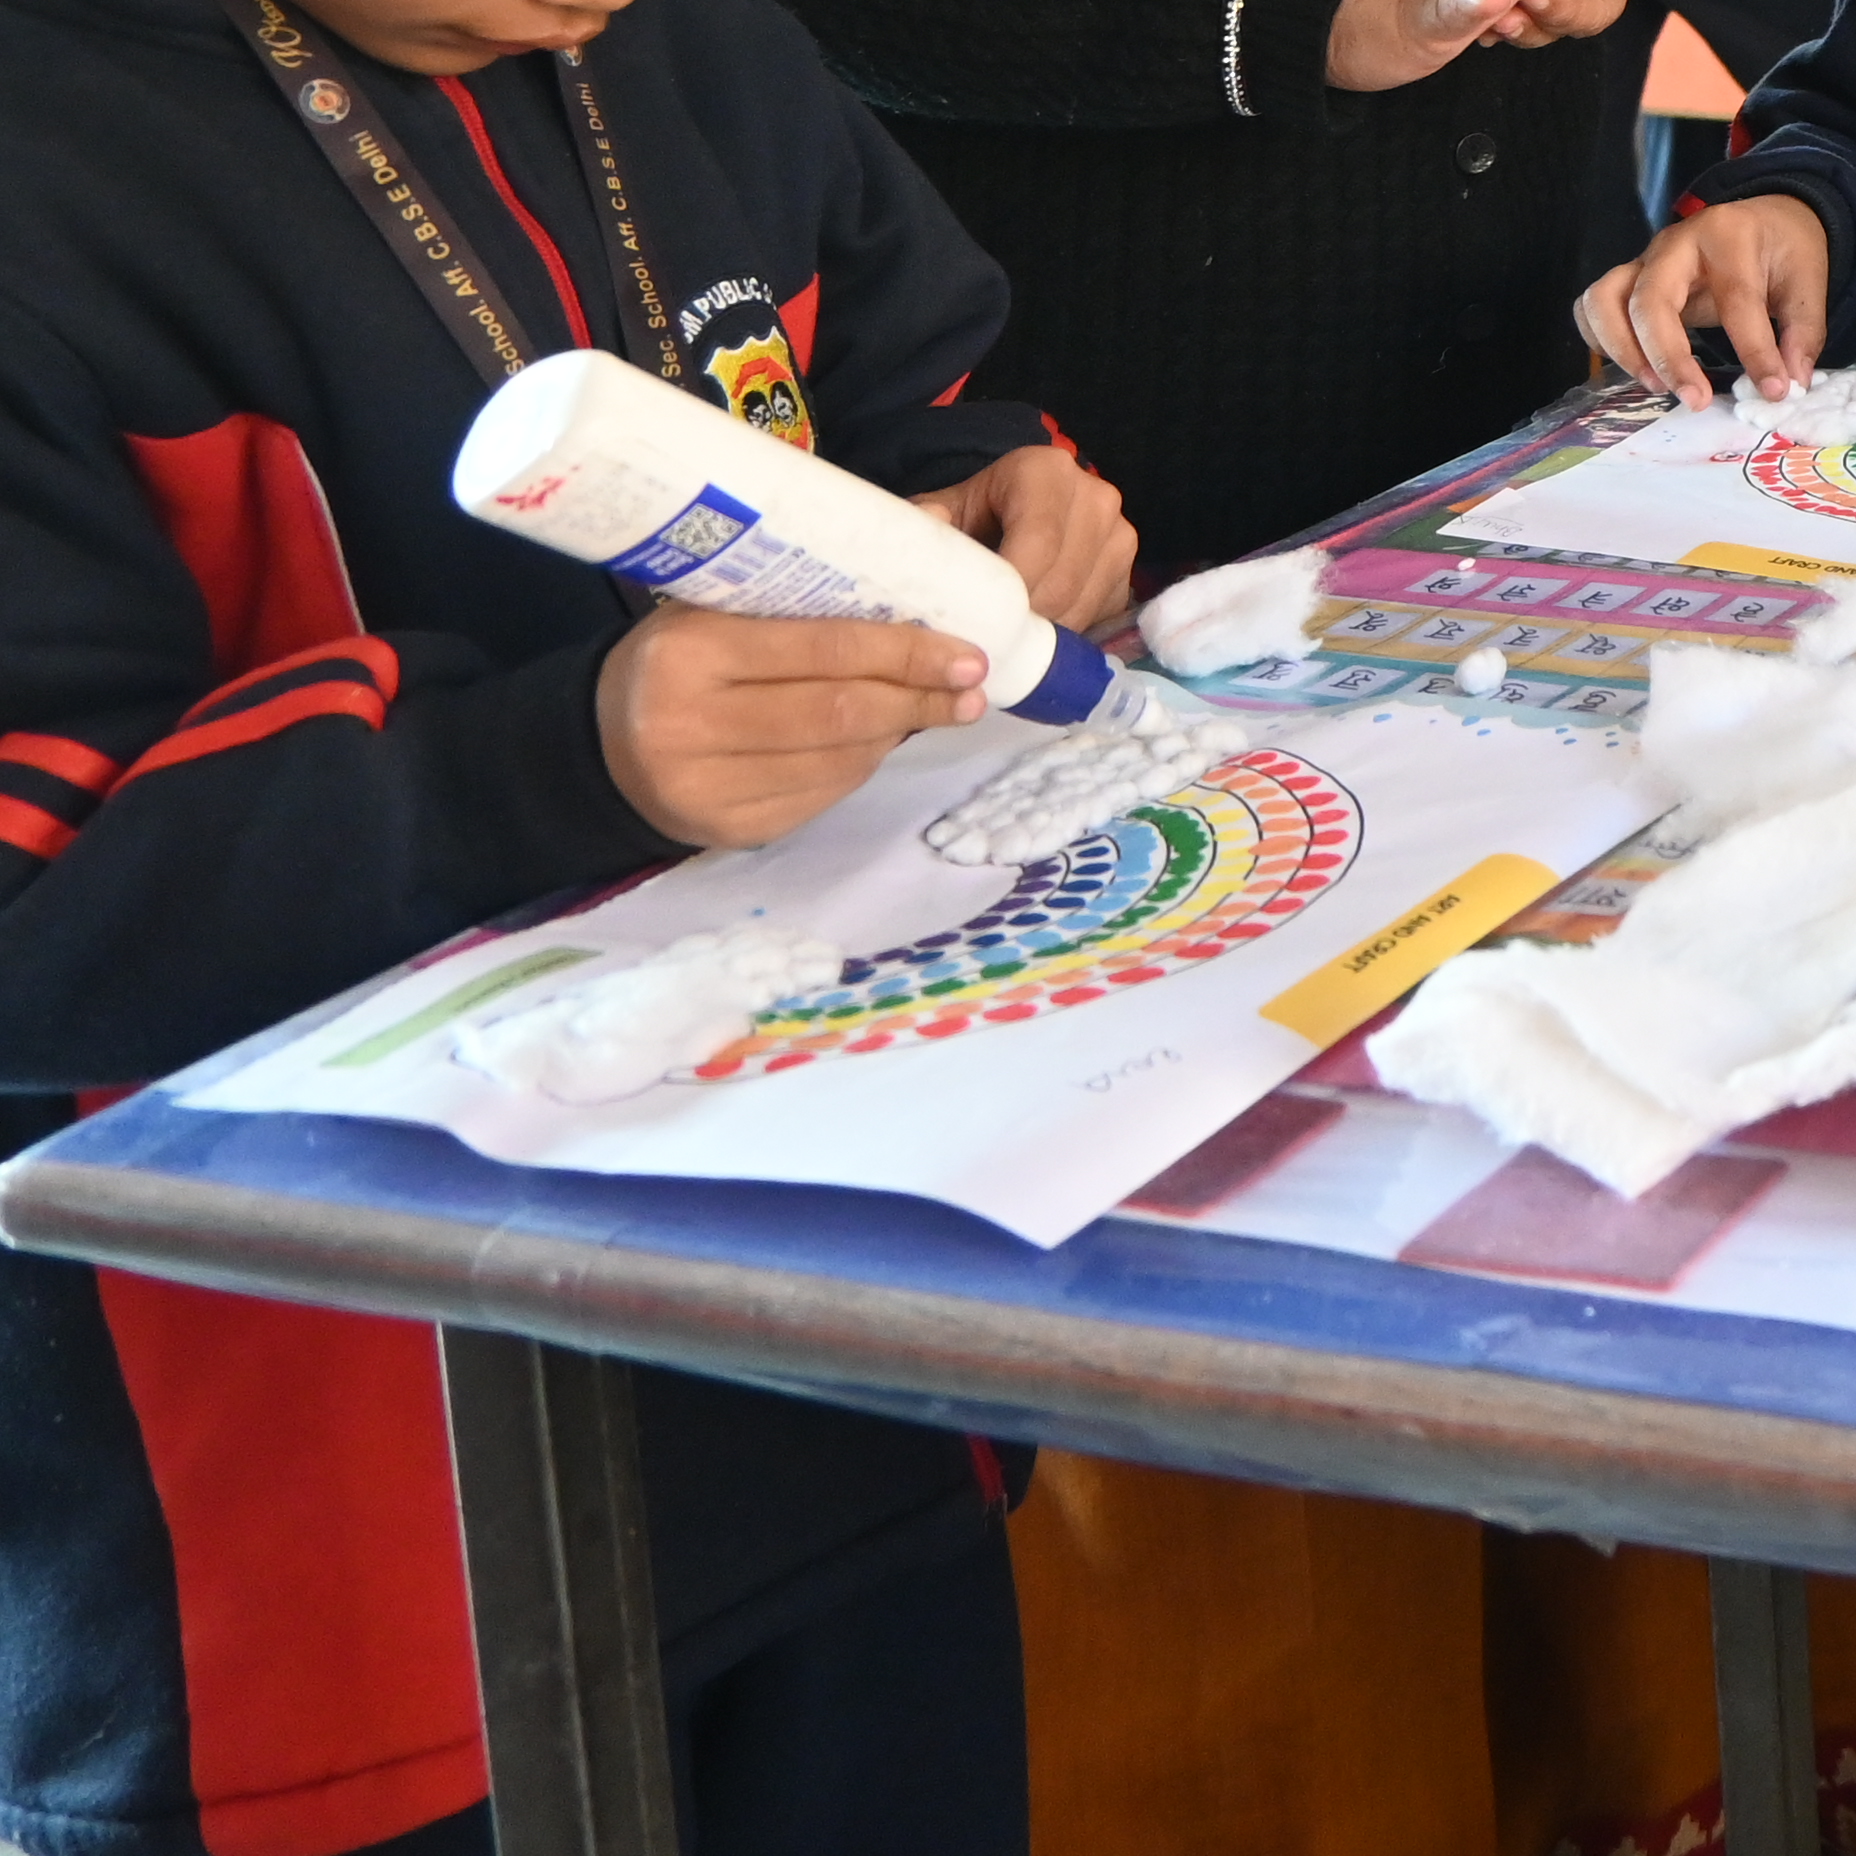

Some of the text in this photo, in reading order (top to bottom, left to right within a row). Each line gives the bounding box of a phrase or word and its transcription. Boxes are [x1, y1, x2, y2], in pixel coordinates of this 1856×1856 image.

[575, 82, 605, 131] Delhi
[349, 129, 399, 185] Delhi
[618, 216, 642, 252] Aff.
[442, 259, 480, 299] Aff.
[692, 276, 763, 322] PUBLIC
[1767, 557, 1822, 570] CRAFT
[1426, 894, 1461, 914] ART
